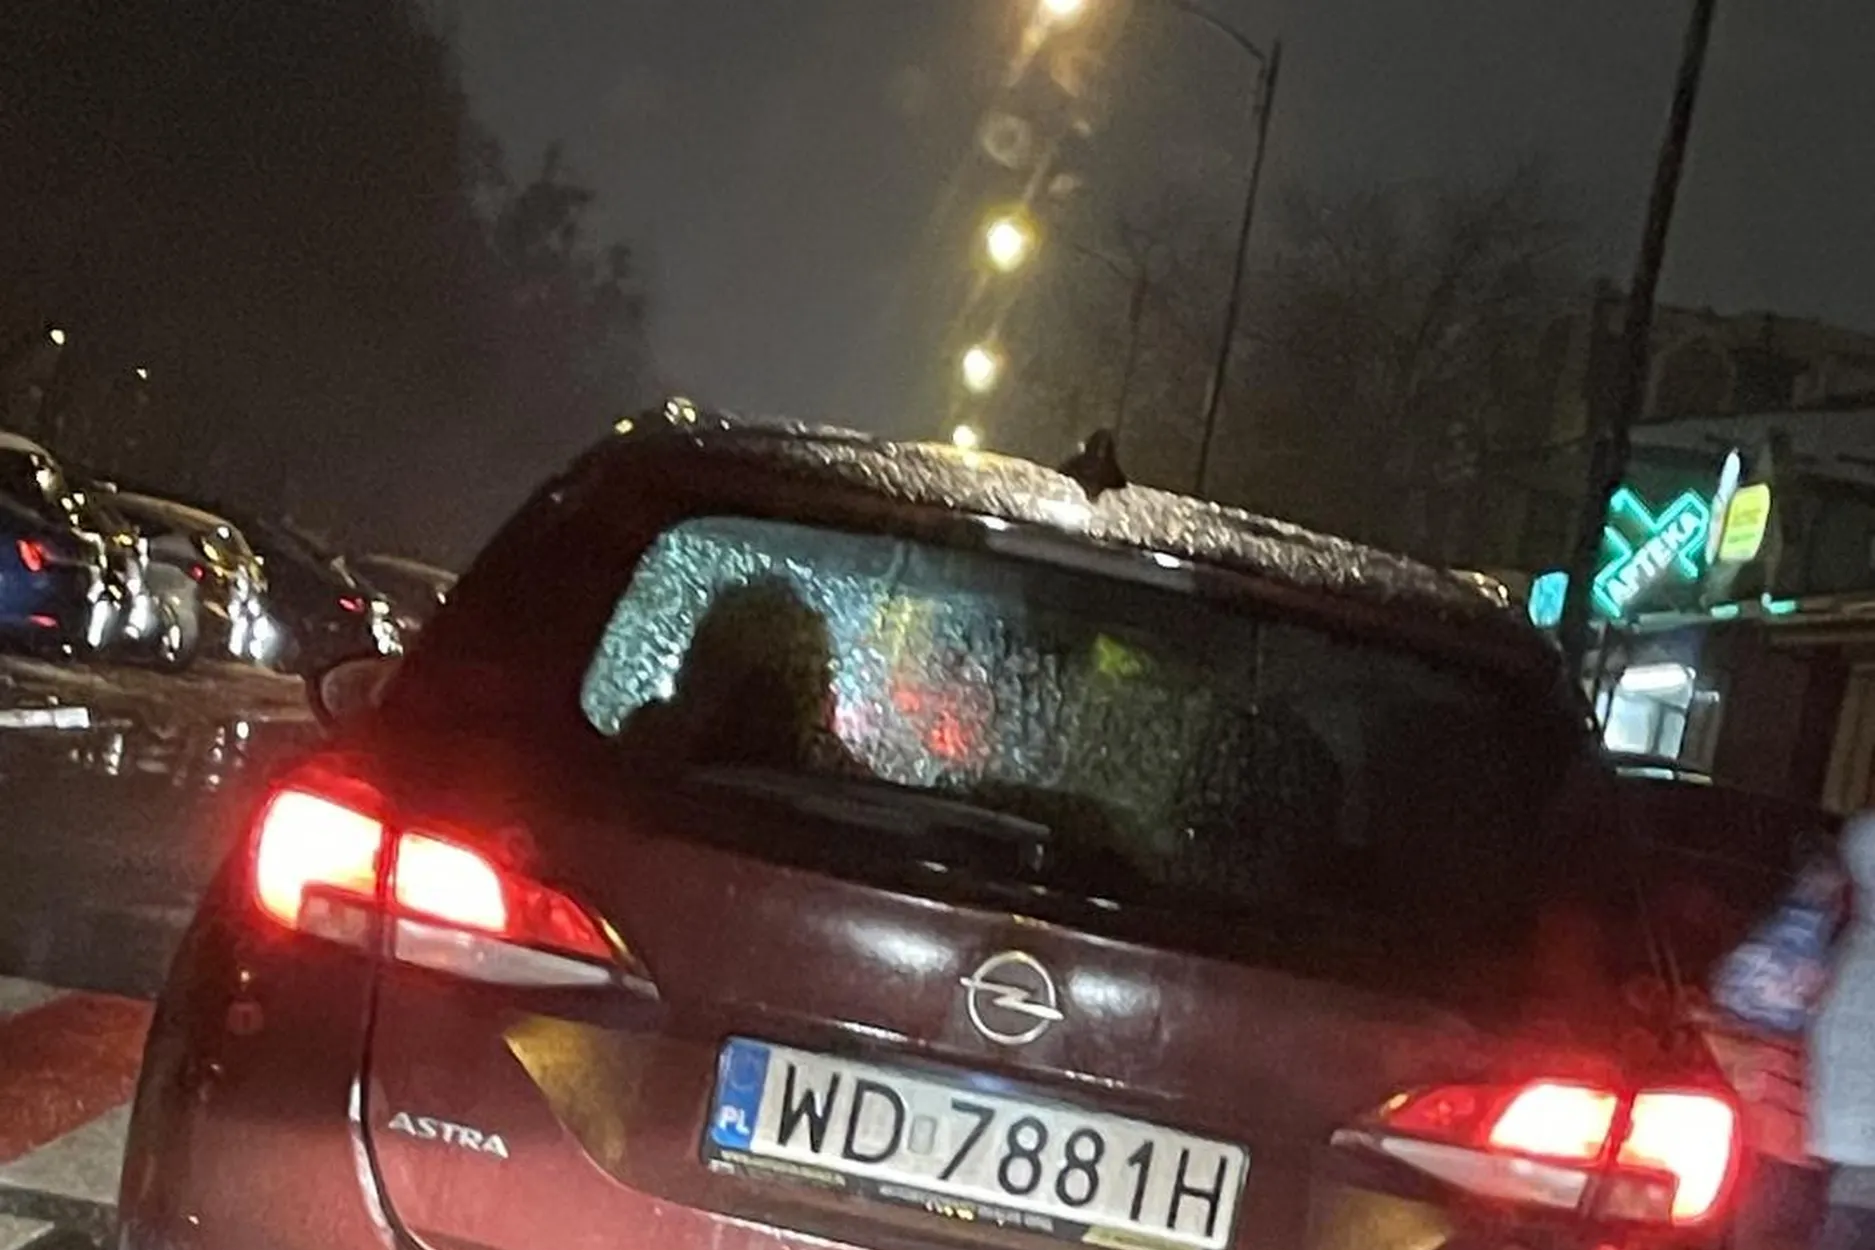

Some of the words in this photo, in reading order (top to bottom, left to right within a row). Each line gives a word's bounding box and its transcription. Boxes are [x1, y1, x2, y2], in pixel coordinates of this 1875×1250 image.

[1605, 511, 1702, 602] APTEKA
[388, 1111, 509, 1159] ASTRA
[719, 1104, 750, 1136] PL
[778, 1063, 908, 1164] WD
[938, 1099, 1229, 1238] 7881H
